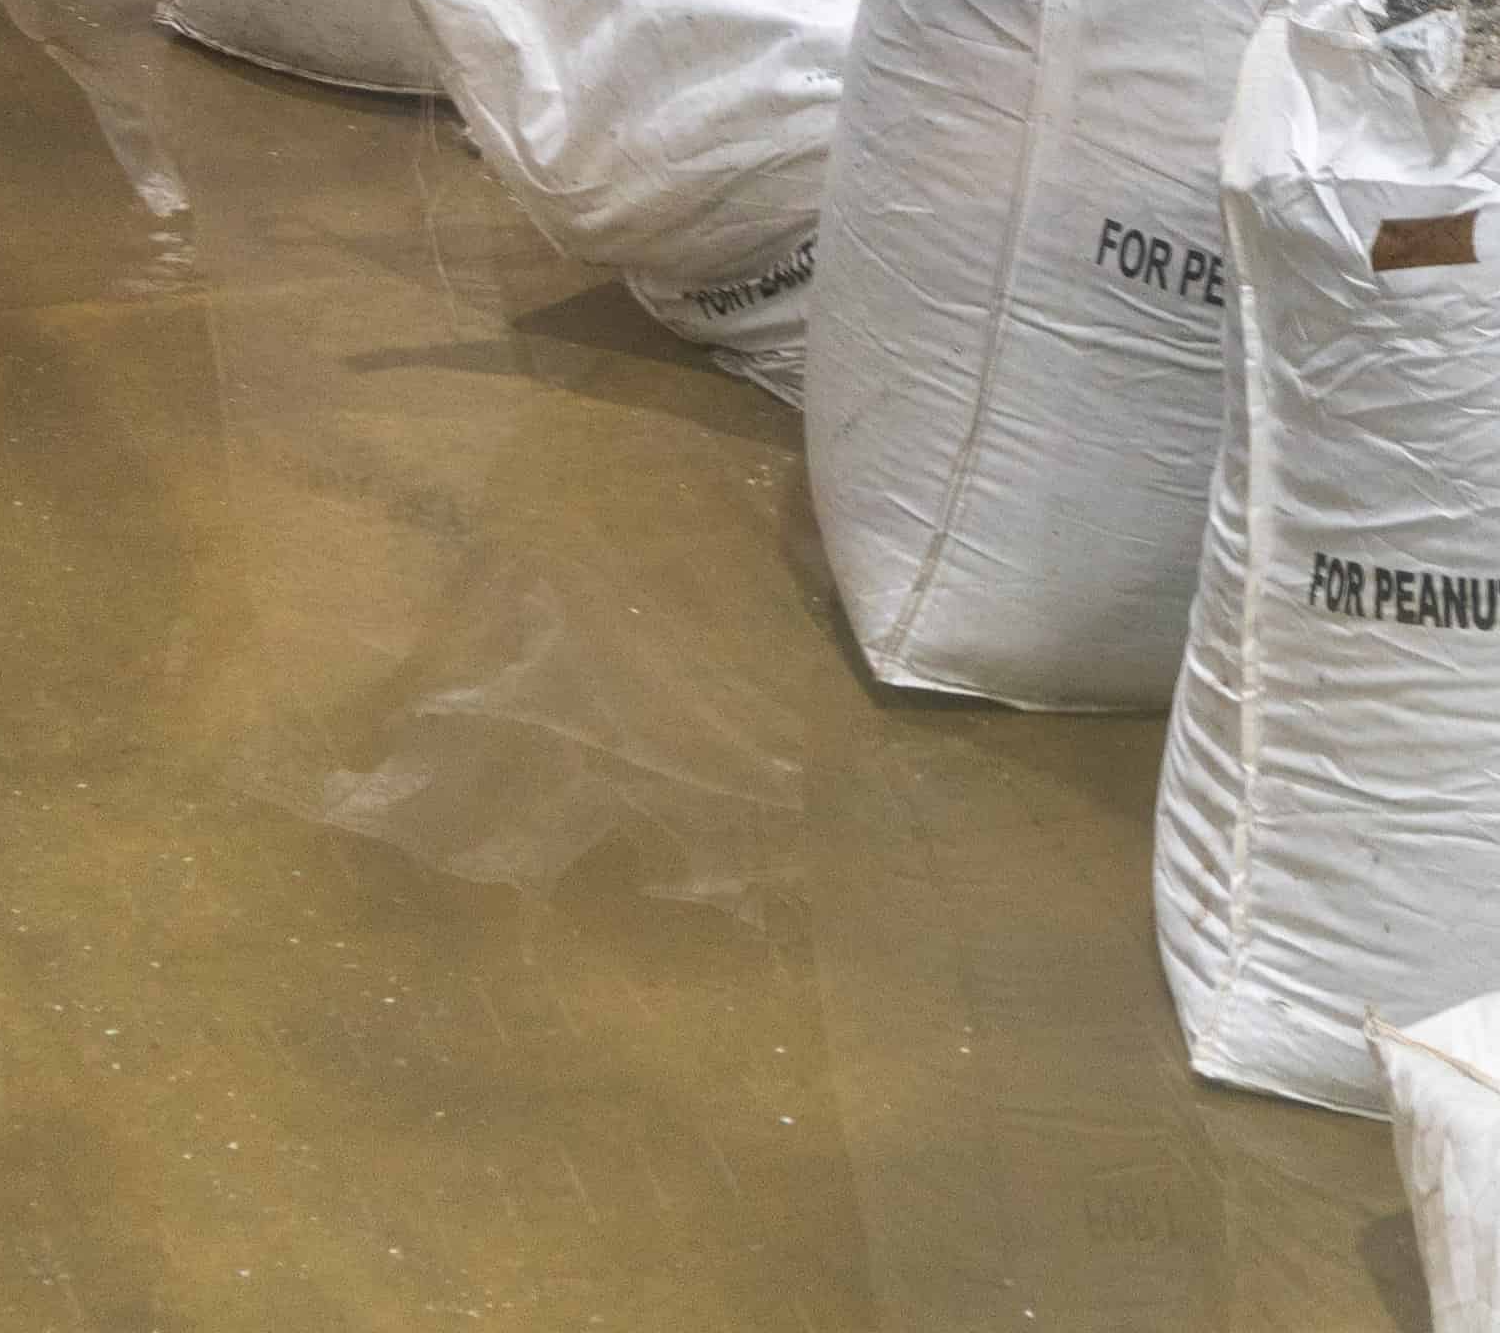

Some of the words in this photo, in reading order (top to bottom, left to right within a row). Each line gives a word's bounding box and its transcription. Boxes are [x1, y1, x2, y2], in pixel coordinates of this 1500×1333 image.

[1097, 217, 1171, 291] FOR
[1179, 249, 1225, 308] PE
[1309, 551, 1366, 617] FOR
